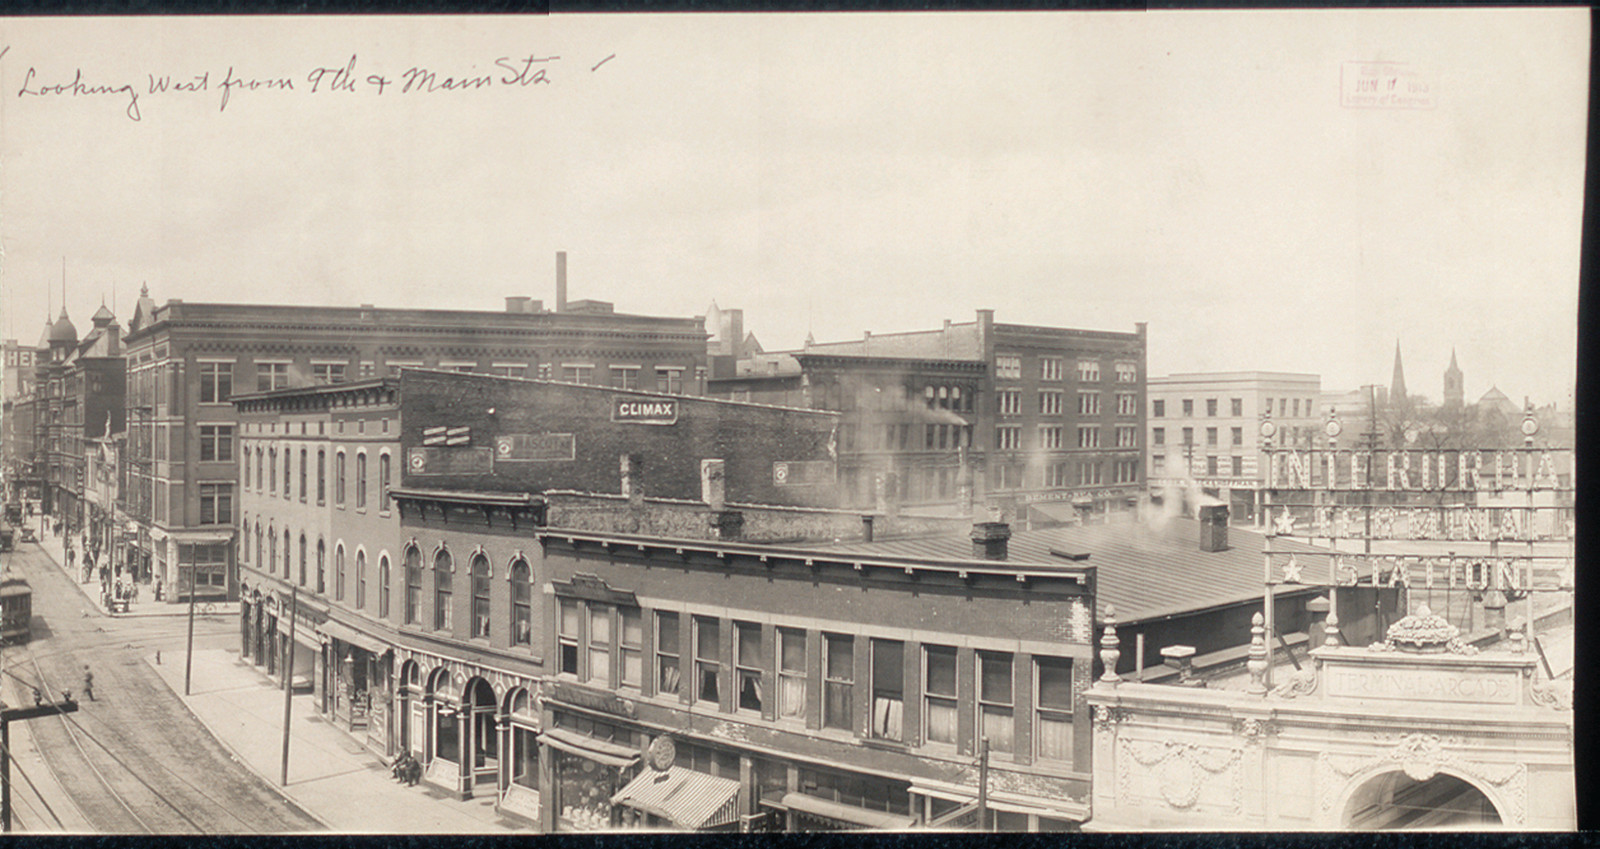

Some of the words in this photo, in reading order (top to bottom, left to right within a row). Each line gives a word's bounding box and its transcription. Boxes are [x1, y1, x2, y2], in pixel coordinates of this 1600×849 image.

[620, 402, 672, 416] CLIMAX
[1271, 450, 1575, 491] INTERURBA
[1336, 556, 1521, 590] STATION
